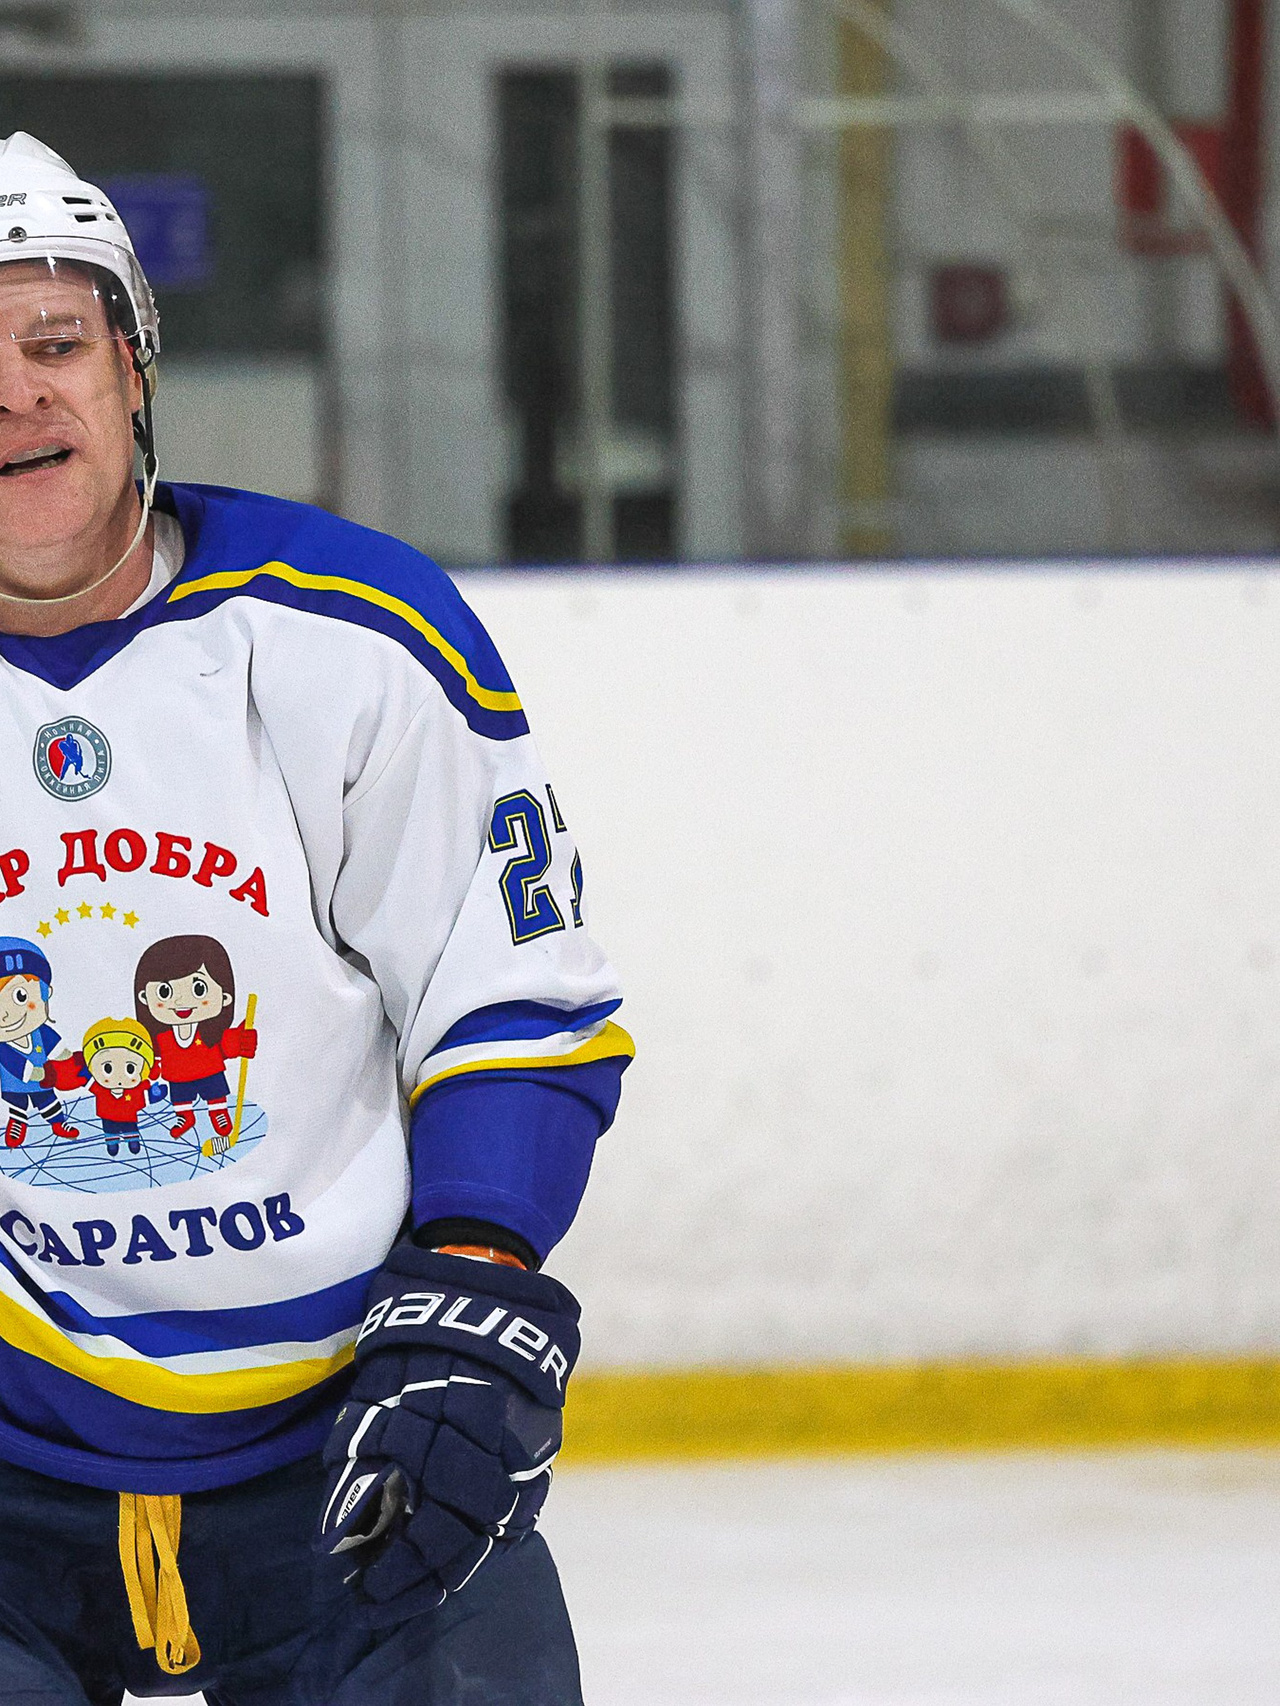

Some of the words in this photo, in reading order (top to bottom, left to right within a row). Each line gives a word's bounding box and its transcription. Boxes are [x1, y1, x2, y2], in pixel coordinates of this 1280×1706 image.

[57, 828, 270, 918] ДОБРА
[0, 1192, 305, 1267] САРАТОВ
[355, 1292, 569, 1392] BAUER
